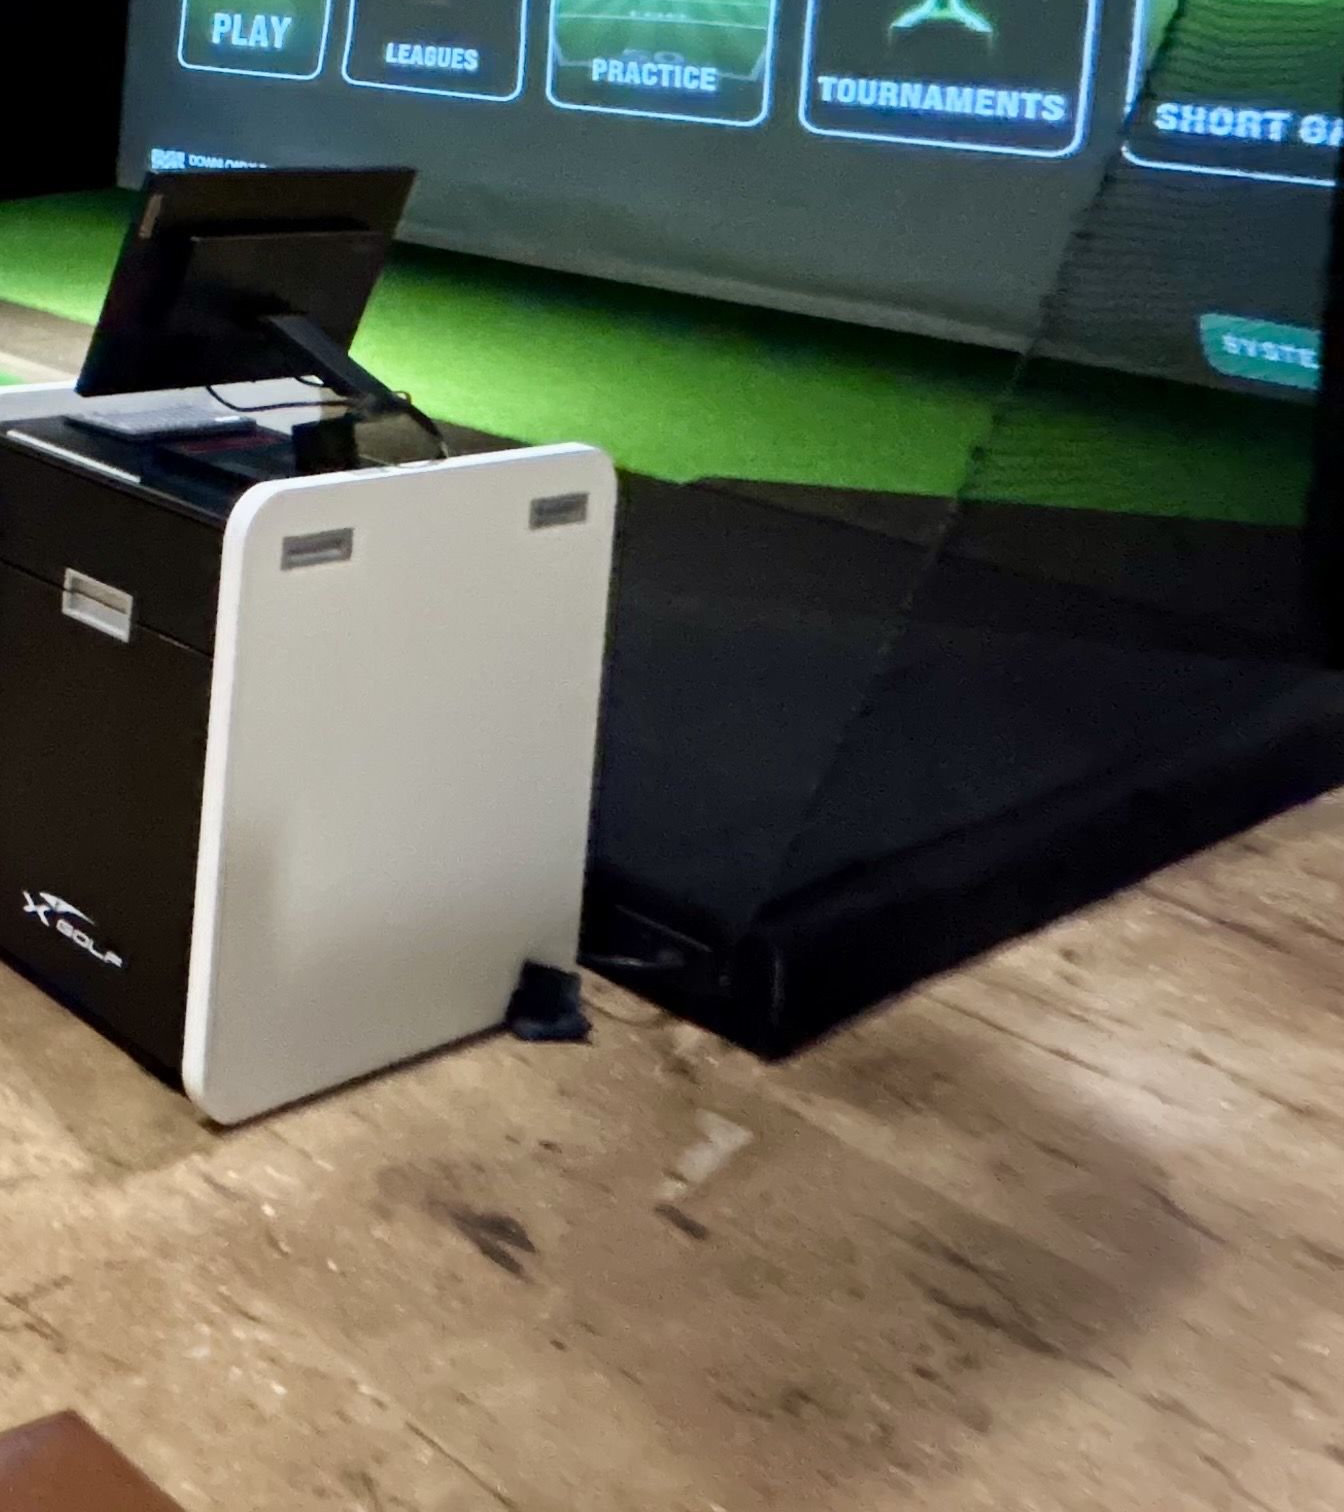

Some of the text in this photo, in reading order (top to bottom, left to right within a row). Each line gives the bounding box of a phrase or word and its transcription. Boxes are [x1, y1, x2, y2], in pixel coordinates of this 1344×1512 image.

[212, 12, 292, 49] PLAY
[386, 42, 480, 71] LEAGUES
[591, 58, 719, 92] PRACTICE
[817, 75, 1066, 123] TOURNAMENTS
[1154, 101, 1293, 143] SHORT
